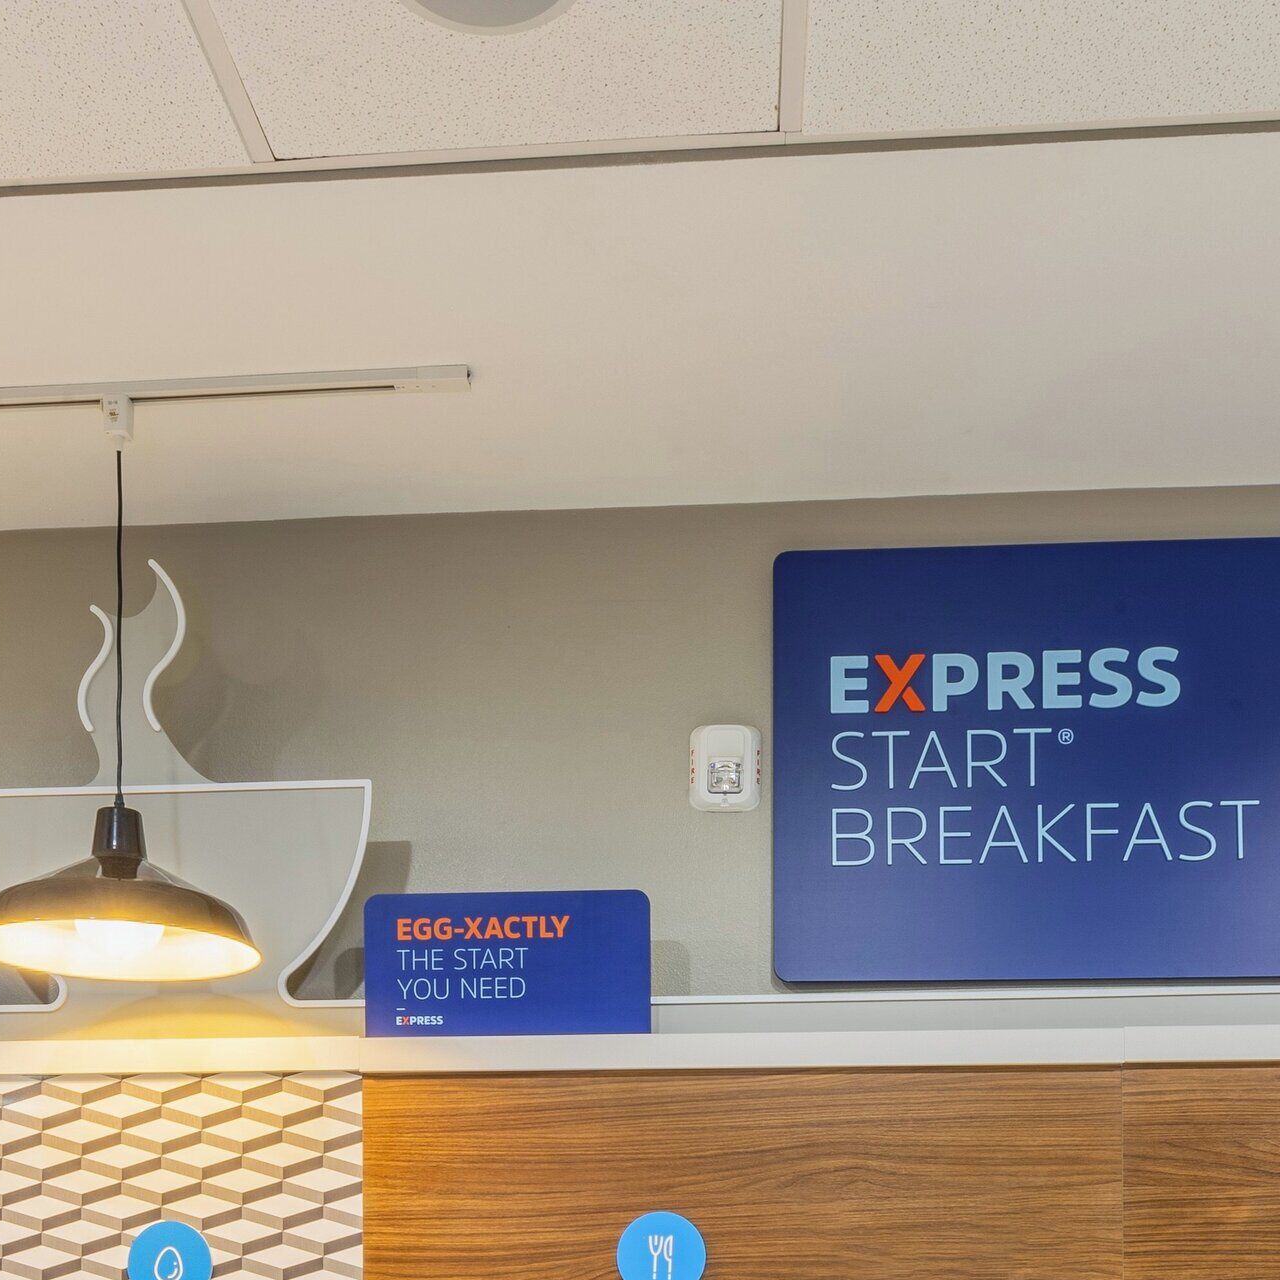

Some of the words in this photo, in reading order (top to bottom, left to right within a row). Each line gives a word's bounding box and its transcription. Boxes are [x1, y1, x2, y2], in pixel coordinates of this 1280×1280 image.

[830, 646, 1181, 714] EXPRESS
[831, 800, 1260, 866] BREAKFAST
[396, 915, 570, 941] EGG-XACTLY
[397, 949, 444, 971] THE
[453, 947, 529, 970] START
[397, 978, 450, 1000] YOU
[460, 977, 526, 999] NEED
[396, 1015, 444, 1026] EXPRESS
